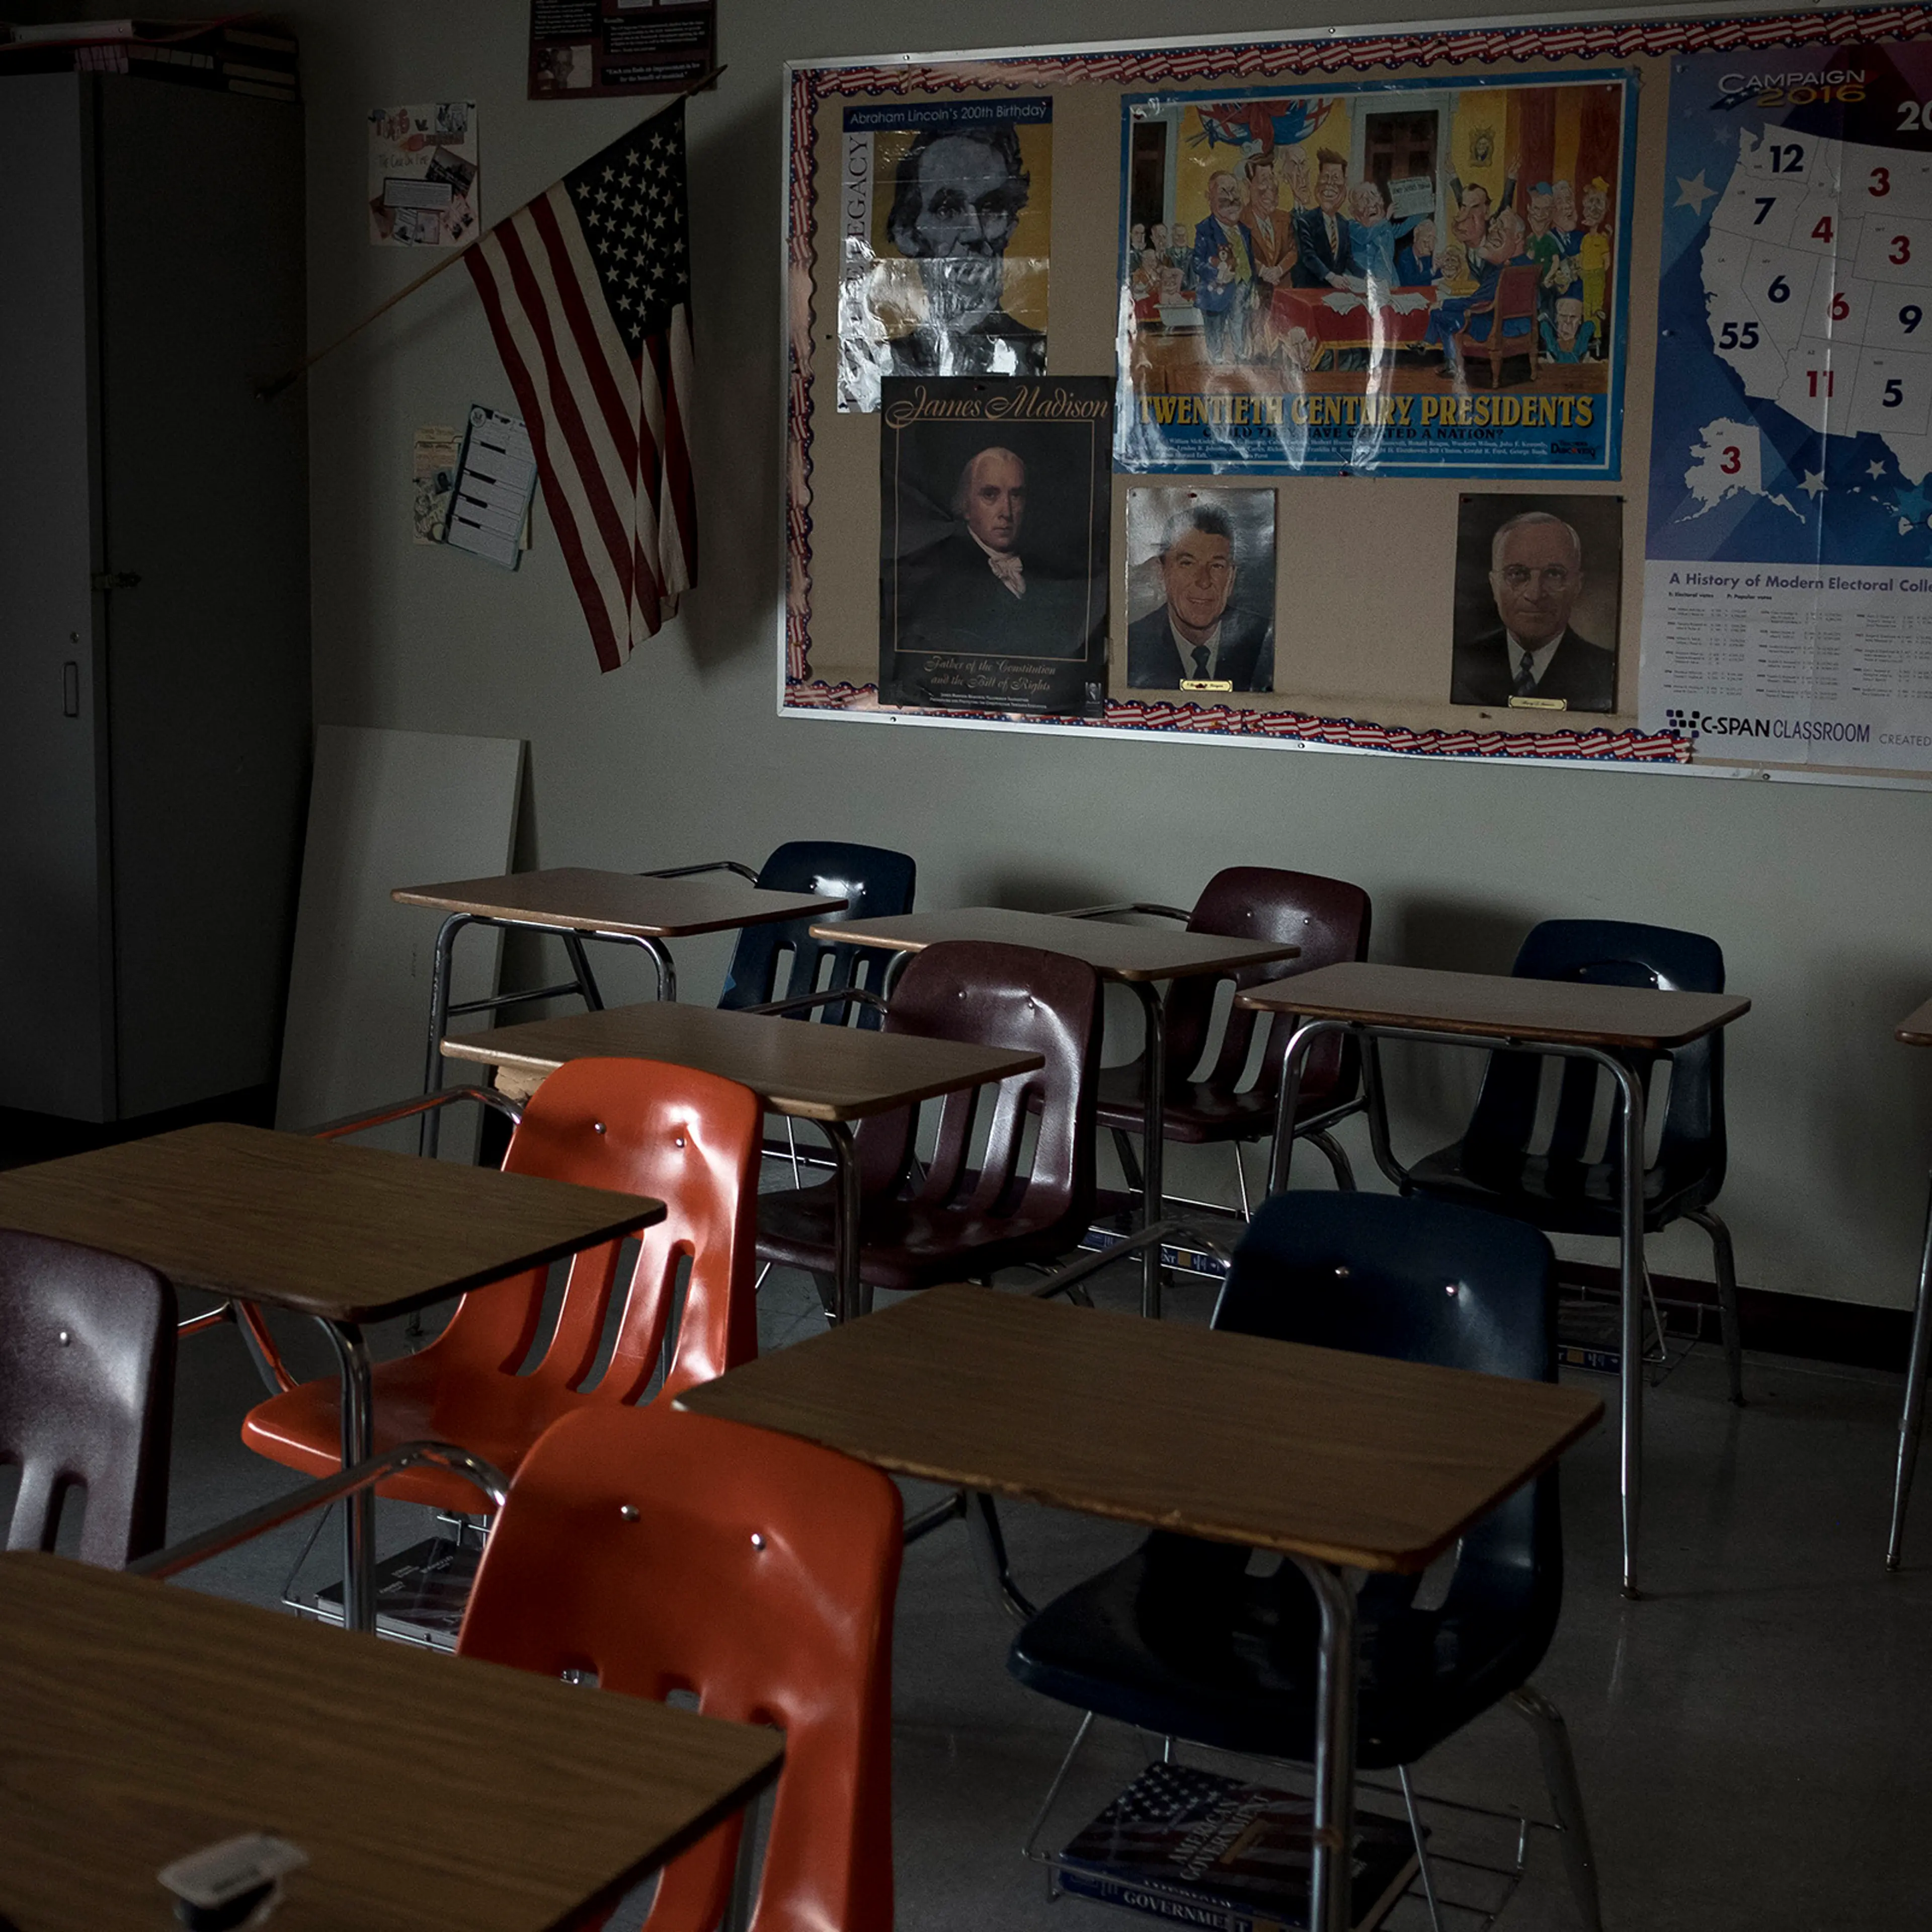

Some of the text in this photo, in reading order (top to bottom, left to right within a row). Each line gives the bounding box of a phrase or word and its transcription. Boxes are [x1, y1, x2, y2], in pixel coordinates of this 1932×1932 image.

[1718, 69, 1865, 94] CAMPAIGN
[1756, 85, 1866, 107] 2016
[850, 104, 1046, 125] Abraham Lincoln's 200th Birthday
[1770, 144, 1804, 173] 12
[1868, 168, 1890, 197] 3
[1754, 198, 1777, 224] 7
[1811, 216, 1833, 243] 4
[1889, 235, 1910, 264] 3
[1767, 276, 1790, 303] 6
[1828, 293, 1849, 320] 6
[1899, 305, 1922, 333] 9
[1719, 323, 1759, 349] 55
[1807, 371, 1833, 397] 11
[1882, 379, 1902, 408] 5
[884, 385, 1108, 429] James Madison
[1139, 395, 1284, 425] TWENTIETH
[1420, 396, 1594, 427] PRESIDENTS
[1422, 428, 1431, 438] A
[1437, 428, 1504, 439] NATION?
[1721, 446, 1741, 474] 3
[1669, 573, 1681, 585] A
[1686, 573, 1740, 590] History
[1745, 574, 1761, 587] of
[1766, 576, 1824, 589] Modern
[1828, 577, 1893, 591] Electoral
[923, 655, 1056, 675] Father of the Constitution
[930, 674, 1051, 694] and the Bill of Rights
[1701, 716, 1931, 747] C-SPAN CLASSROOM CREATED
[1122, 1890, 1248, 1932] GOVERNMET
